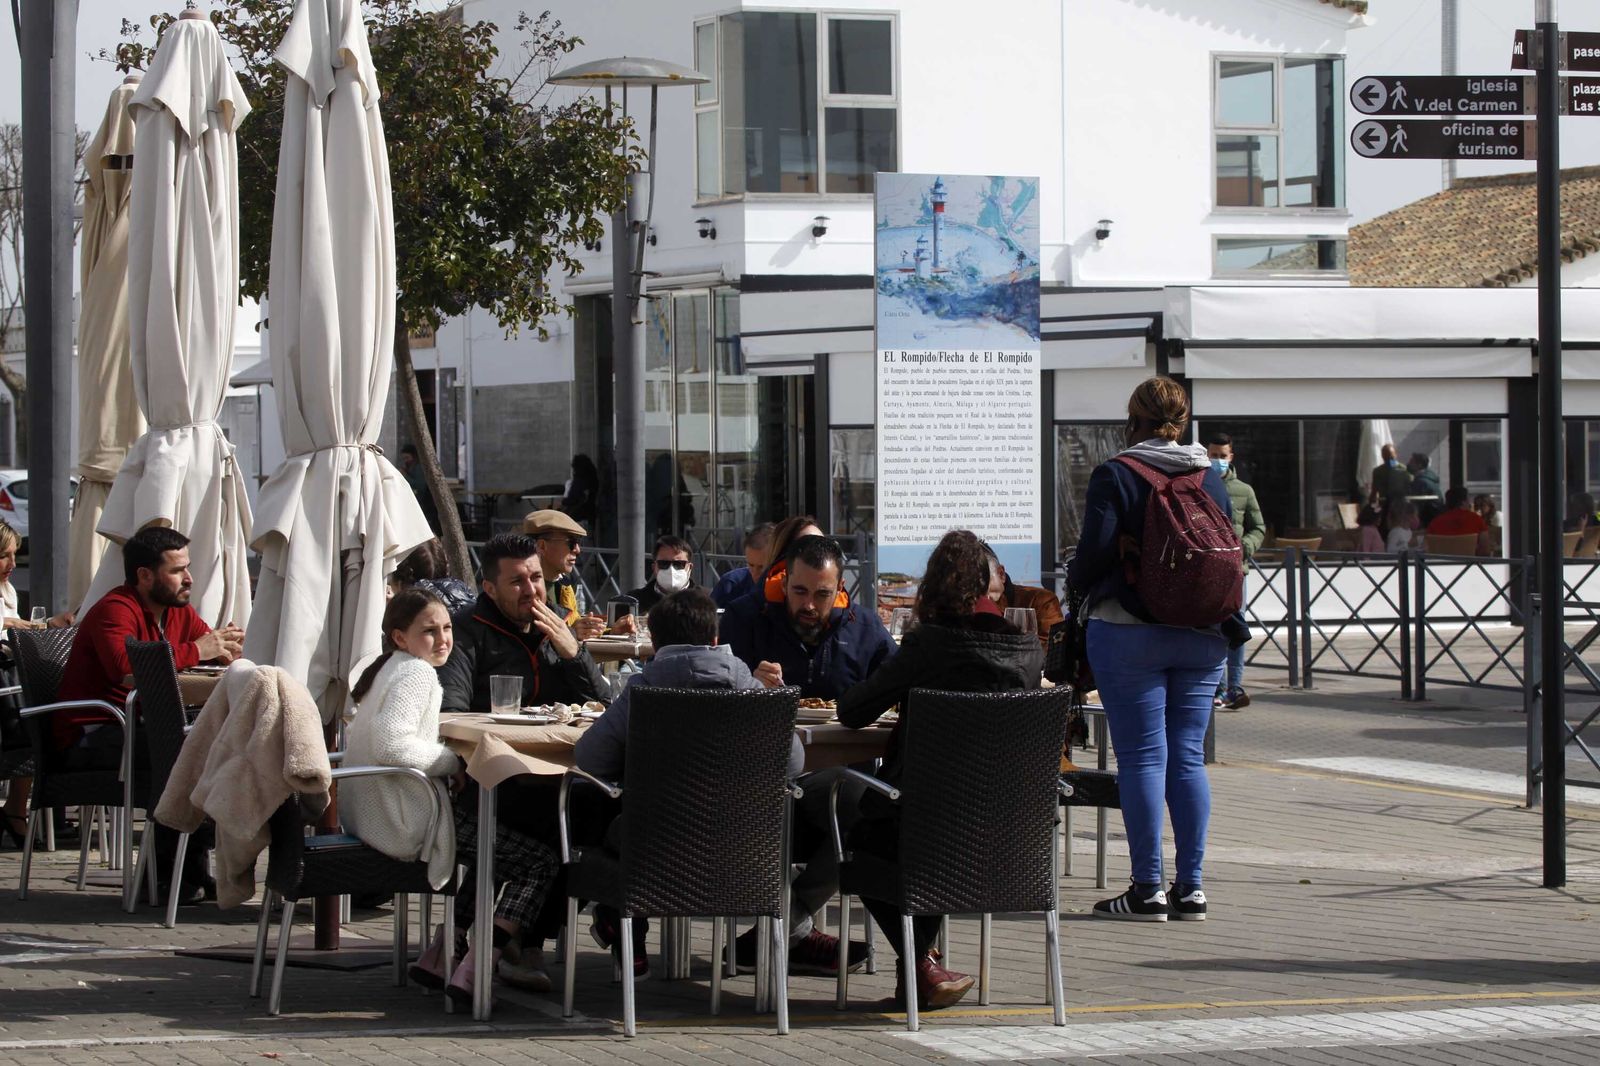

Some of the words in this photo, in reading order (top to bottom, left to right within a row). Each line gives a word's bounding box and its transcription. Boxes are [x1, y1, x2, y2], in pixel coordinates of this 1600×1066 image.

[1467, 79, 1517, 94] iglesia
[1415, 99, 1452, 112] V.del
[1457, 99, 1517, 112] Carmen
[1574, 100, 1593, 111] Las
[1442, 123, 1494, 136] oficina
[1500, 123, 1518, 136] de
[1458, 143, 1518, 156] turismo
[884, 351, 896, 363] EL
[969, 352, 979, 363] de
[984, 352, 992, 363] El
[998, 352, 1032, 366] Rompido
